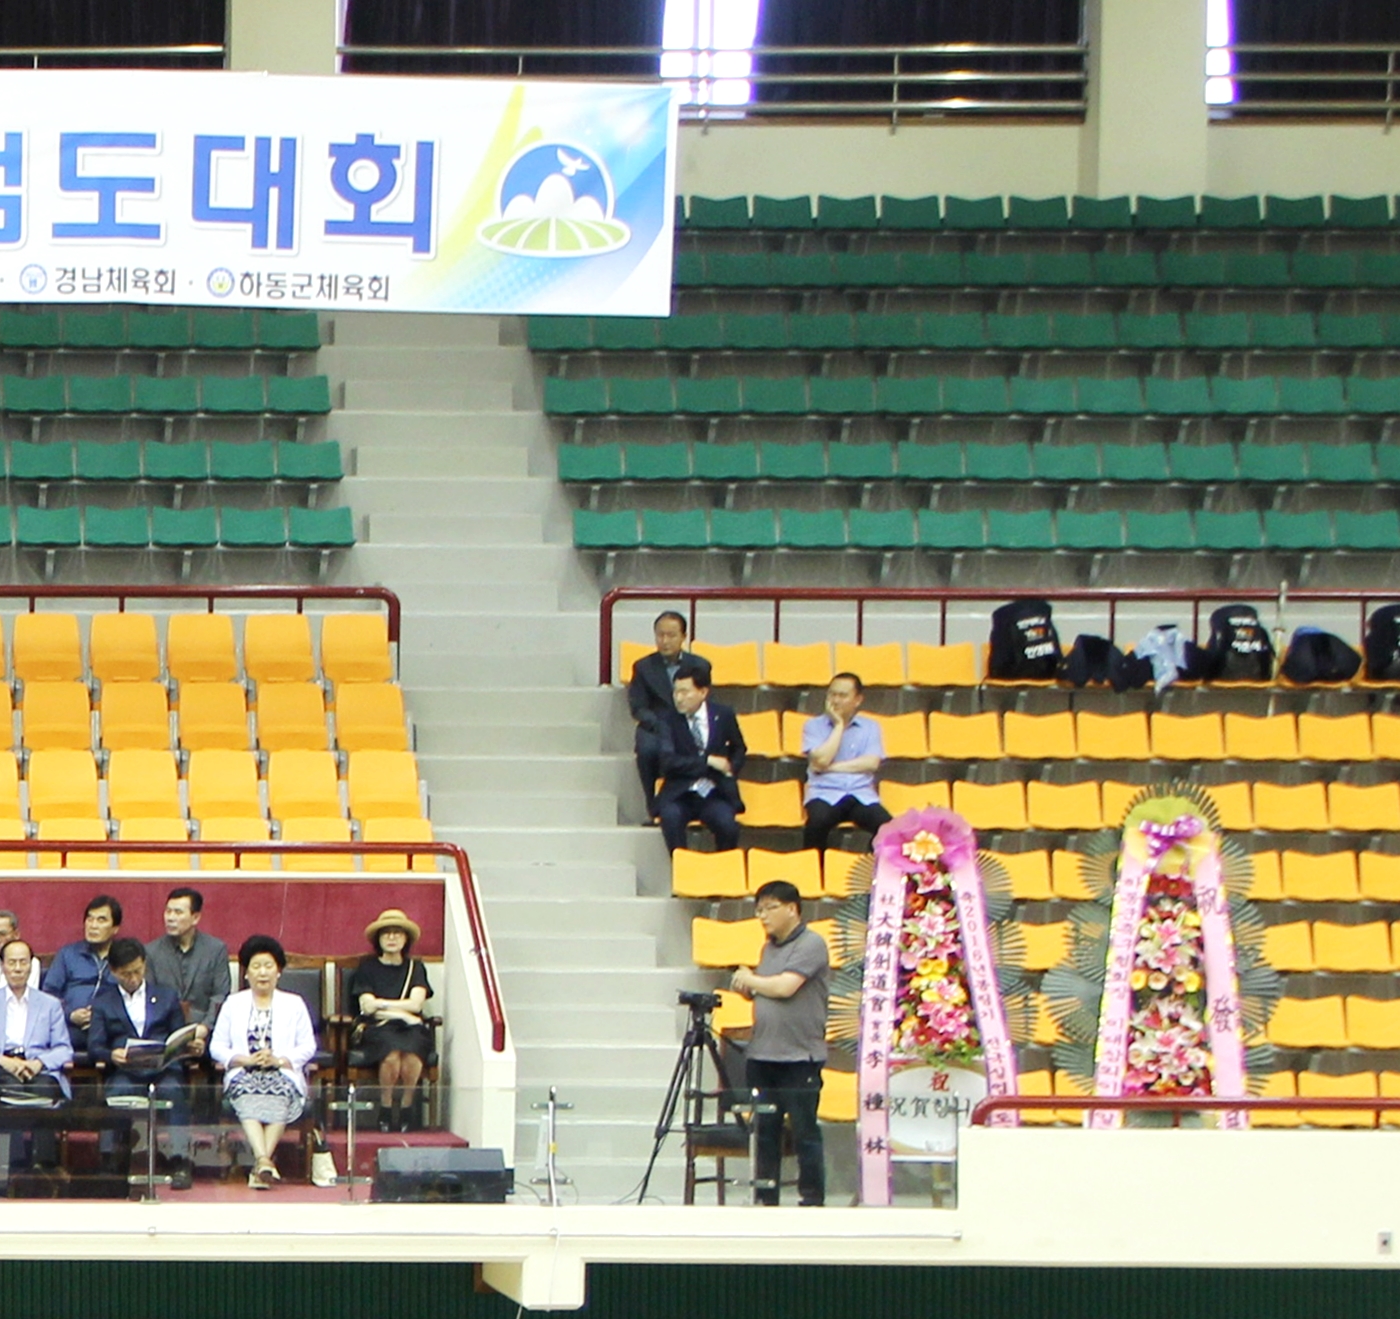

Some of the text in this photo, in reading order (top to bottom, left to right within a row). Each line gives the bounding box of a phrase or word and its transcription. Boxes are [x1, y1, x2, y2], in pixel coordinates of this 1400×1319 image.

[55, 267, 177, 296] 경남체육회
[239, 271, 391, 302] 하동군체육회
[985, 1037, 1014, 1126] 전국실업도
